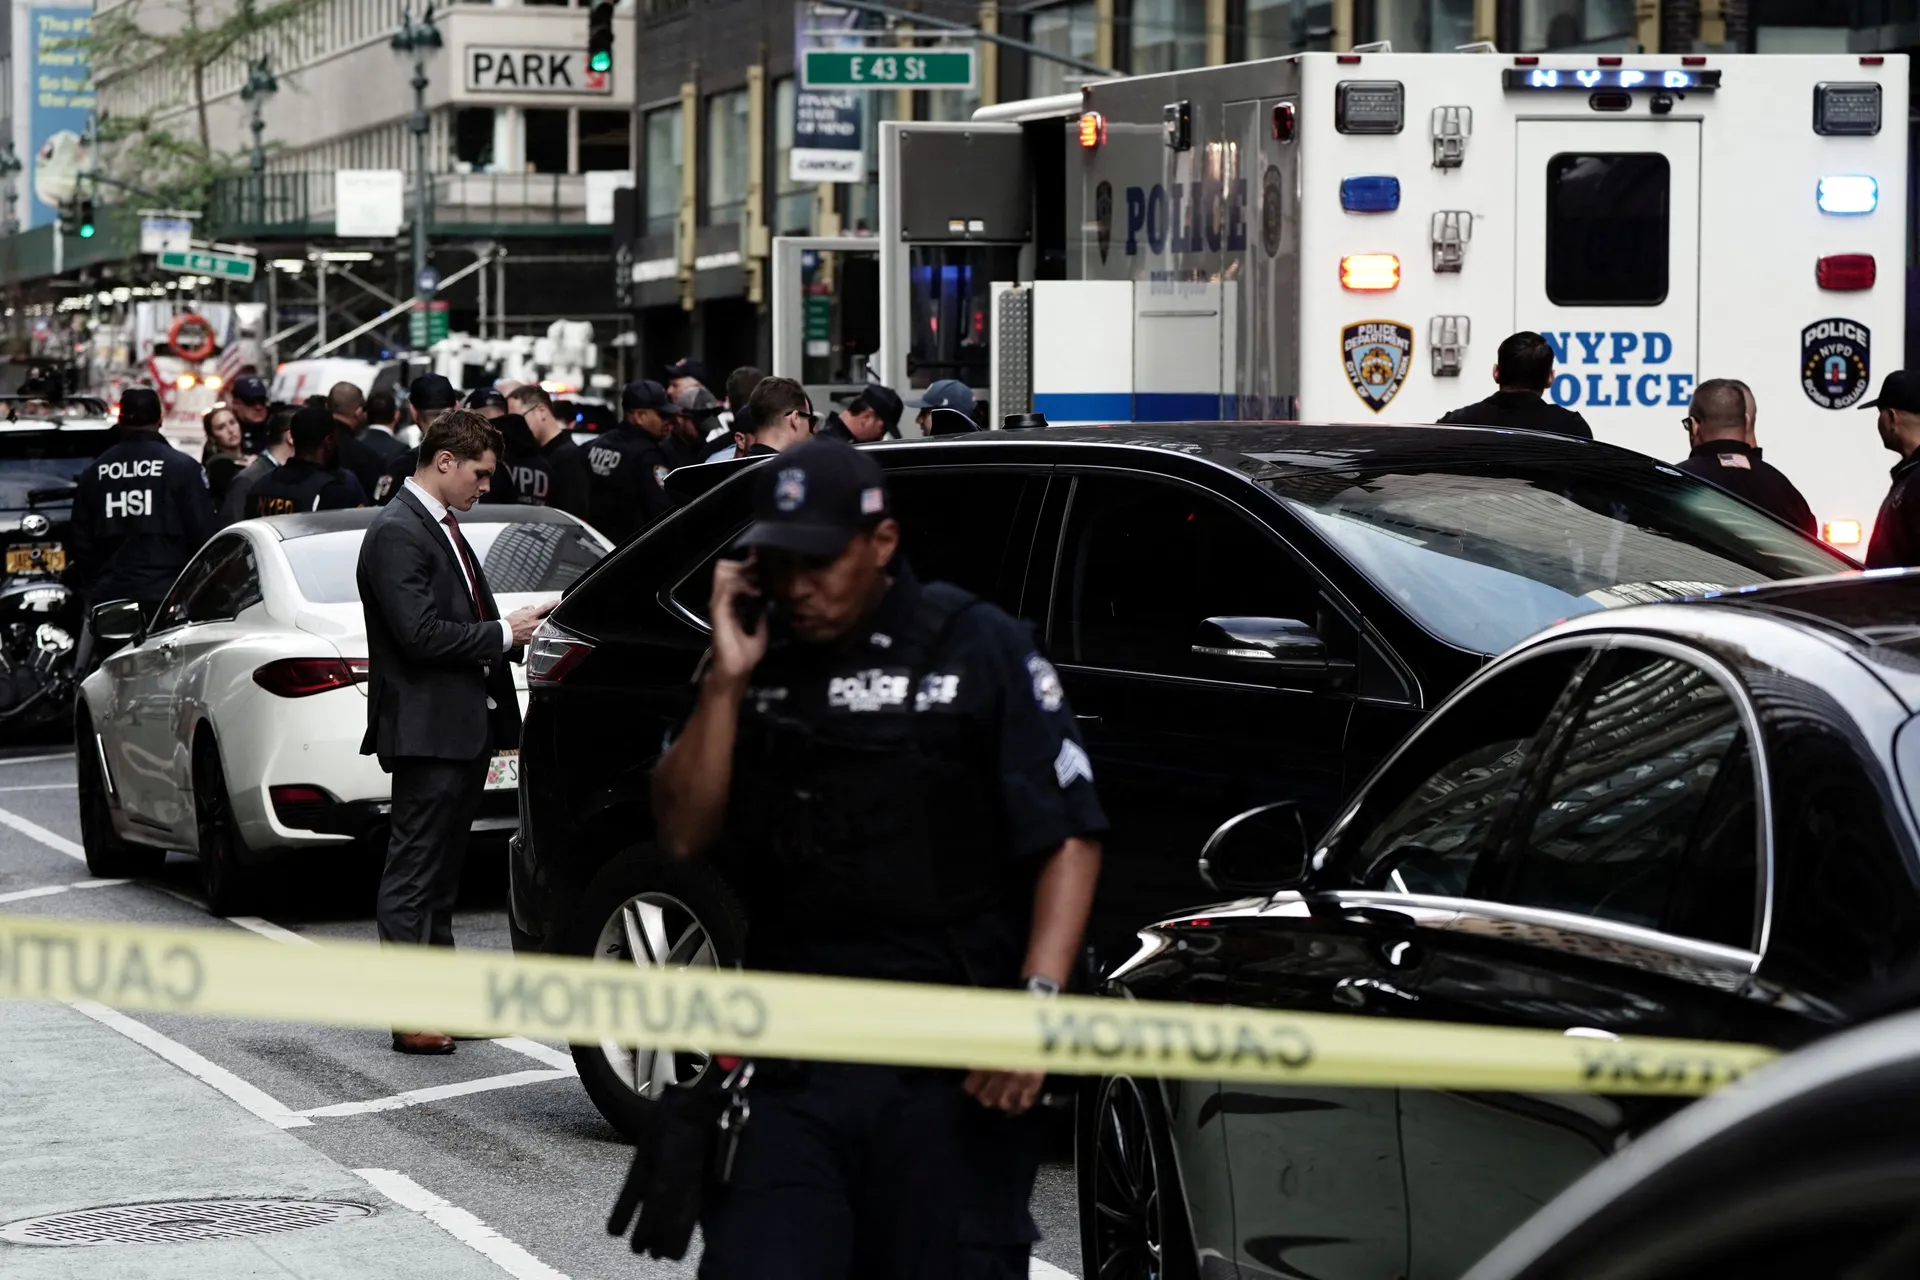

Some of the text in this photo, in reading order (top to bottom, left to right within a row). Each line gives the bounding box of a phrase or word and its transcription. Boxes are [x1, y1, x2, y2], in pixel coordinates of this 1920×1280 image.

[474, 53, 571, 87] PARK
[850, 57, 927, 80] E 43 St
[1125, 179, 1248, 256] POLICE
[1345, 333, 1410, 351] DEPARTMENT
[1358, 323, 1397, 336] POLICE
[1804, 321, 1868, 348] POLICE
[1541, 332, 1672, 364] NYPD
[1819, 344, 1852, 358] NYPD
[1346, 361, 1361, 383] CITY
[1382, 355, 1410, 403] NEW YORK
[1551, 373, 1693, 407] OLICE
[1804, 378, 1867, 408] BOMB SQUAD
[98, 460, 165, 481] POLICE
[588, 446, 621, 469] NYPD
[506, 464, 549, 497] YPD
[105, 489, 152, 518] HSI
[23, 588, 66, 601] INDIAN
